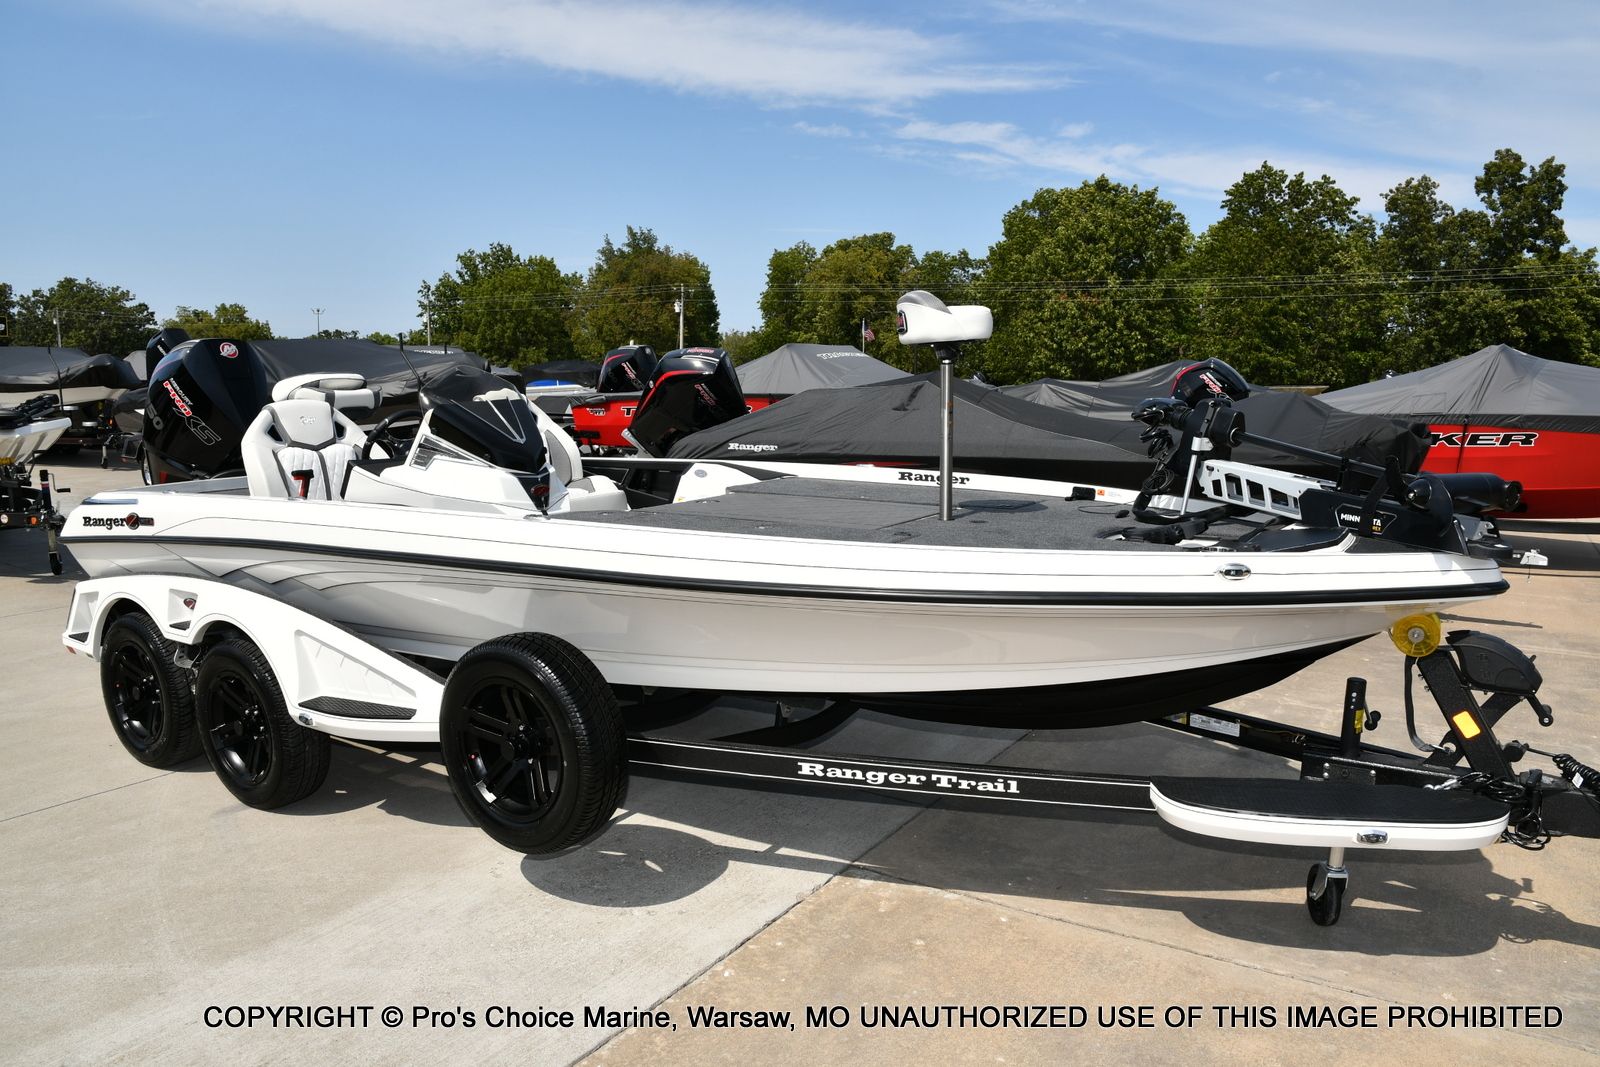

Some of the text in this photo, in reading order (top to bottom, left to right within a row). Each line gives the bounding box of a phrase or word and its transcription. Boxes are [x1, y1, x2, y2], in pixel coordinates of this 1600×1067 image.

[728, 442, 778, 453] Ranger
[82, 516, 127, 530] Ranger
[1340, 513, 1361, 523] MINN
[797, 761, 1020, 794] Ranger Trail
